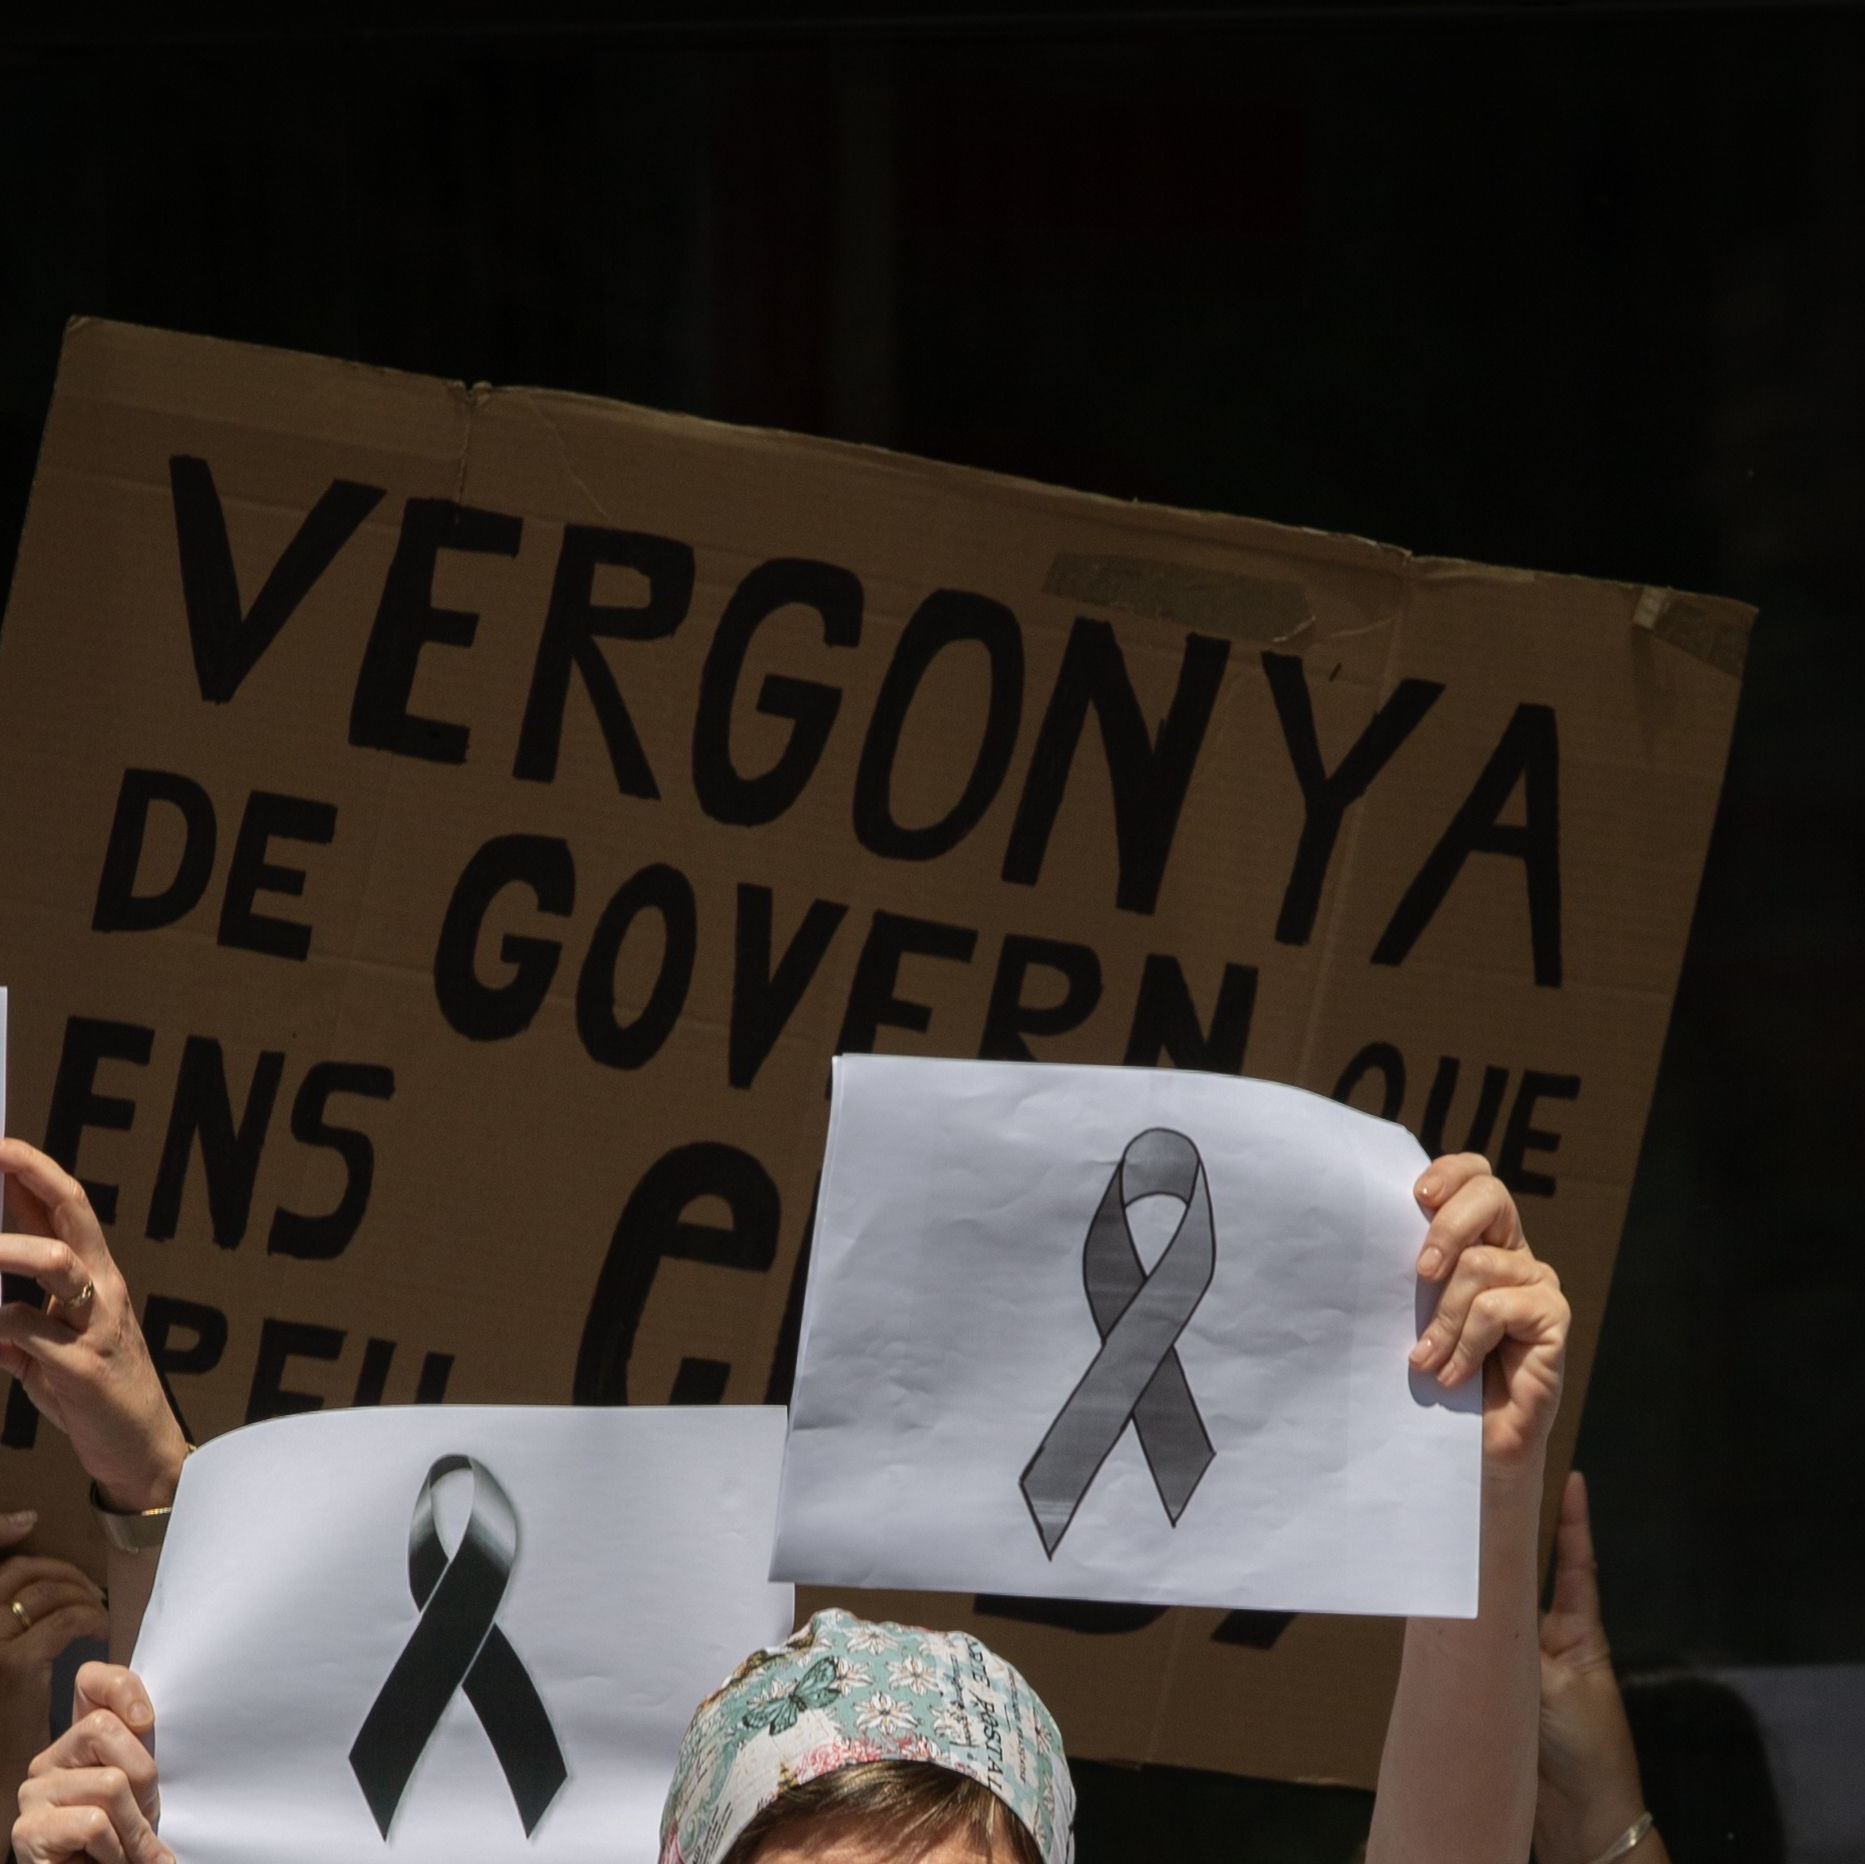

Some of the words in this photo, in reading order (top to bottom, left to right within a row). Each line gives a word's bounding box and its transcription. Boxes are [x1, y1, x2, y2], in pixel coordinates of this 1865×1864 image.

[169, 455, 1563, 988] VERGONYA
[93, 768, 339, 963] DE
[44, 1016, 396, 1260] ENS
